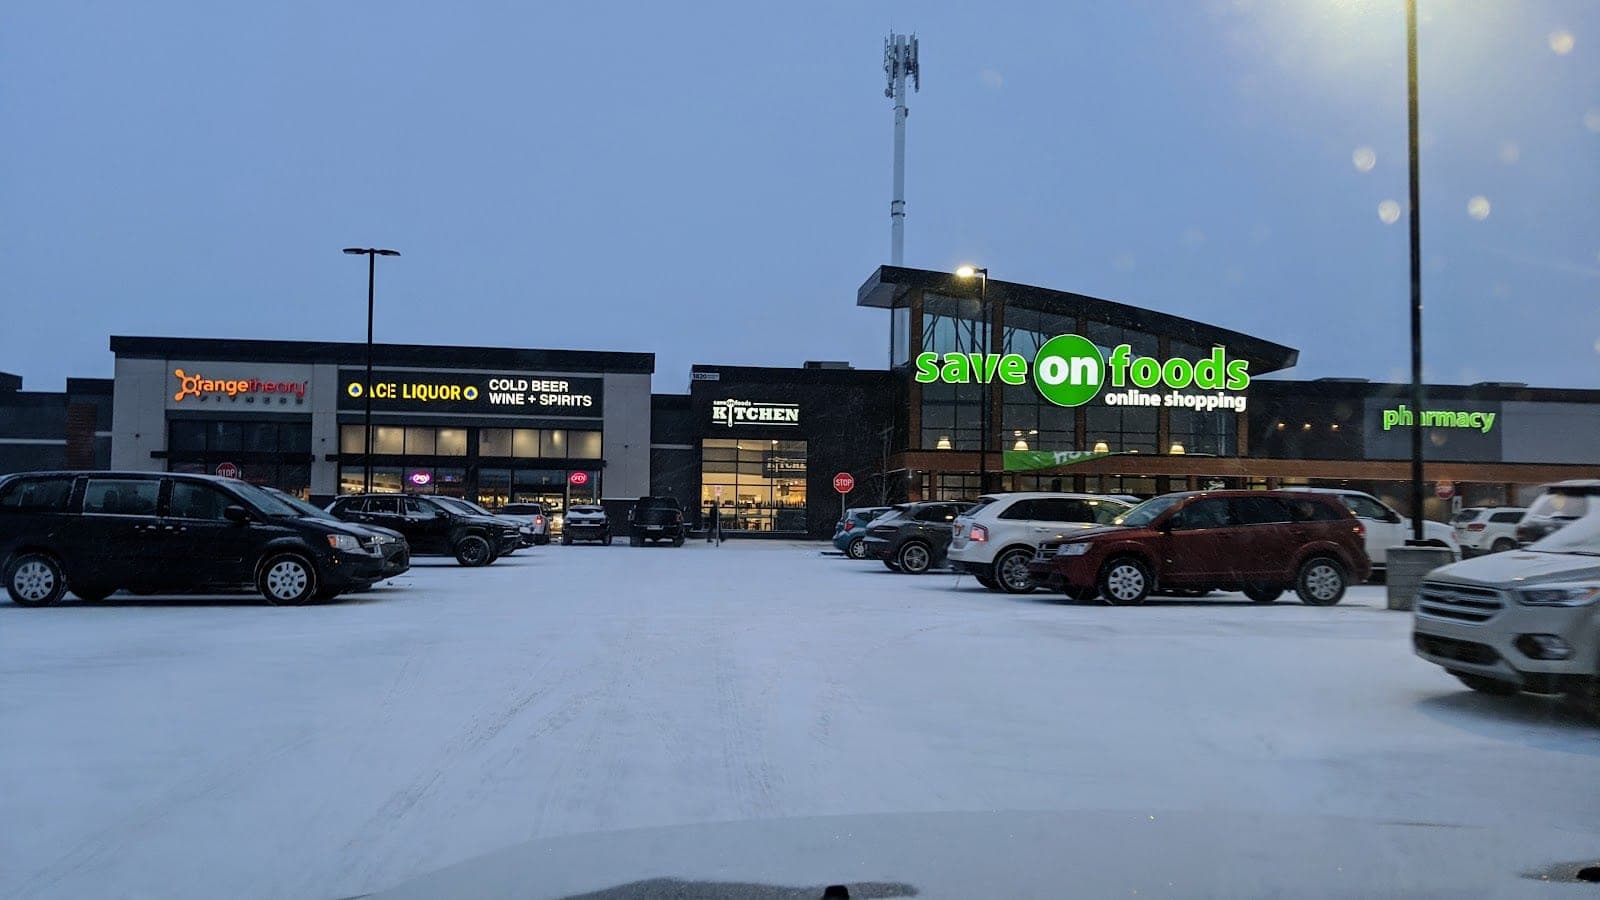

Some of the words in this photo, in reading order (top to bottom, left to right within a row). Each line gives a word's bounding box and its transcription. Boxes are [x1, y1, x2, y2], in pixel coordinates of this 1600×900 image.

[915, 352, 1027, 384] save
[1039, 355, 1099, 386] on
[1108, 344, 1251, 390] foods
[403, 384, 460, 401] LIQUOR
[489, 379, 528, 391] COLD
[531, 381, 568, 392] BEER
[489, 393, 524, 405] WINE
[528, 395, 536, 403] +
[540, 394, 592, 406] SPIRITS
[1105, 390, 1161, 406] online
[1164, 391, 1246, 412] shopping
[712, 405, 799, 423] KITCHEN
[835, 479, 852, 487] STOP
